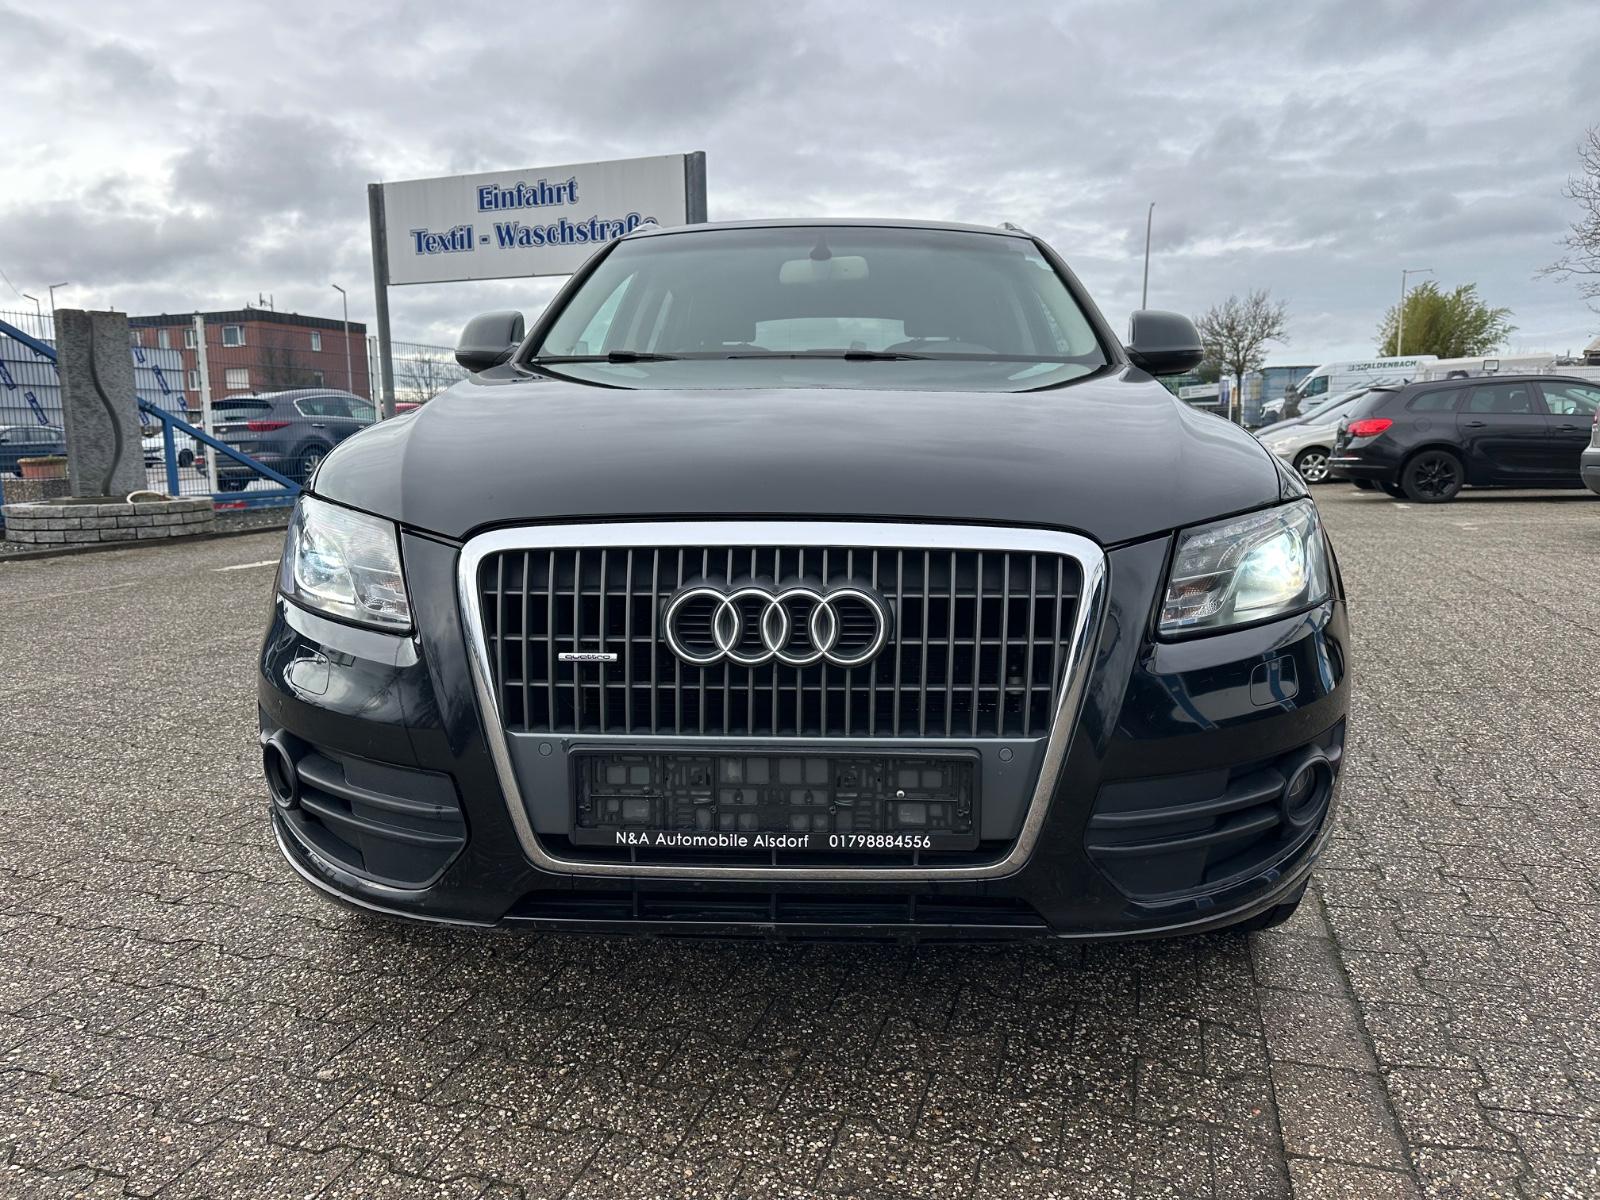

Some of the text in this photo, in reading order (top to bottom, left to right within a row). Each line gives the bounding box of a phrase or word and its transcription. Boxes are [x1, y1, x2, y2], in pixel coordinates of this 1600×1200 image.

[477, 177, 579, 212] Einfahrt
[410, 224, 474, 255] Textil
[494, 212, 659, 249] Waschstraß
[615, 831, 931, 849] N&A Automobile Alsdorf 01798884556
